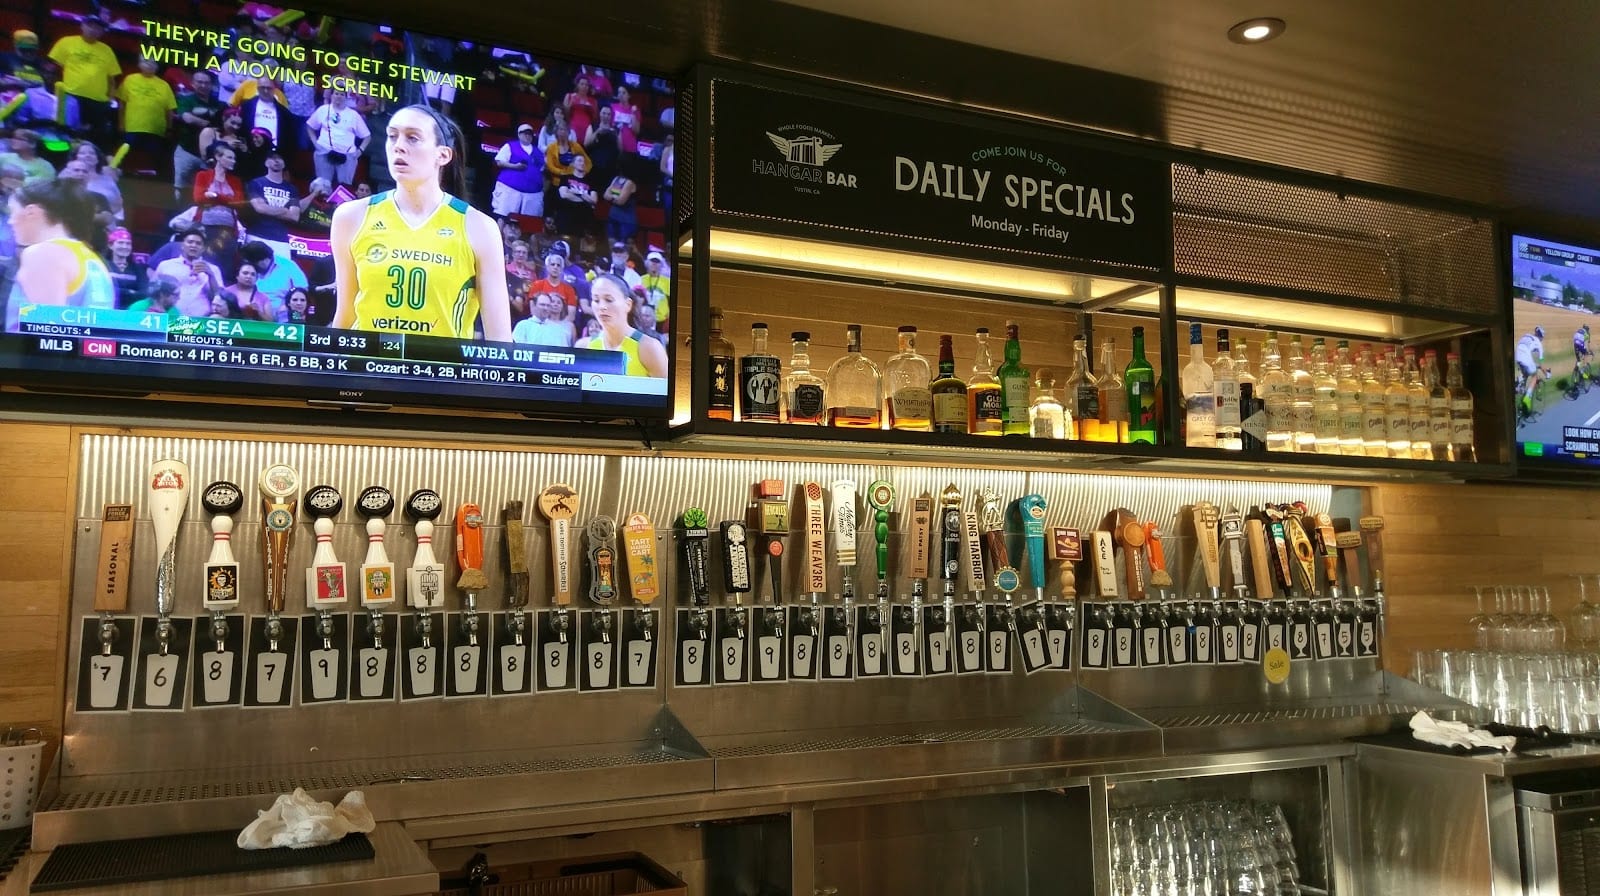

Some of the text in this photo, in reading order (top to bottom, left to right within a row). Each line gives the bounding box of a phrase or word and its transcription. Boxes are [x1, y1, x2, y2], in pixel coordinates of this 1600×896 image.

[142, 20, 476, 91] THEY'RE GOING TO GET STEWART
[141, 44, 398, 102] WITH A MOVING SCREEN,
[972, 146, 1067, 177] COME JOIN US FOR
[752, 160, 858, 188] HANGAR BAR
[896, 156, 1135, 224] DAILY SPECIALS
[972, 214, 1022, 236] Monday
[1032, 224, 1069, 243] Friday
[391, 249, 452, 267] SWEDISH
[386, 265, 426, 310] 30
[62, 309, 97, 324] CHI
[140, 315, 161, 329] 41
[372, 316, 430, 332] verizon
[26, 324, 82, 335] TIMEOUTS:
[206, 319, 244, 335] SEA
[273, 325, 297, 340] 42
[40, 339, 73, 351] MLB
[174, 335, 224, 345] TIMEOUTS:
[310, 334, 366, 348] 3rd 9:33
[88, 343, 112, 354] CIN
[461, 345, 576, 365] WNBA ON ESPN
[120, 345, 348, 370] Romano: 4 IP, 6 H, 6 ER, 5 BB, 3 K
[366, 361, 526, 383] Cozart: 3-4, 2B, HR(10), 2 R
[542, 372, 579, 386] Suárez
[1566, 428, 1579, 437] LOOK
[1580, 429, 1592, 439] HOW
[810, 503, 822, 536] THREE
[630, 538, 650, 546] TART
[966, 514, 983, 580] KING HARBOR
[631, 548, 651, 556] CART
[107, 542, 119, 594] SEASONAL
[1029, 637, 1037, 648] 7
[1092, 634, 1099, 649] 8
[1149, 637, 1155, 649] 7
[1174, 633, 1181, 647] 8
[1200, 632, 1206, 648] 8
[1226, 632, 1233, 648] 8
[1246, 633, 1253, 647] 8
[1272, 634, 1279, 647] 6
[1297, 631, 1304, 643] 8
[1321, 633, 1327, 645] 7
[1341, 631, 1348, 643] 5
[1363, 628, 1370, 642] 5
[797, 643, 806, 660] 8
[834, 643, 842, 660] 8
[867, 641, 876, 658] 8
[902, 640, 910, 655] 8
[934, 640, 941, 655] 9
[966, 638, 975, 654] 8
[995, 638, 1002, 654] 8
[1053, 638, 1060, 654] 9
[1120, 636, 1127, 651] 8
[460, 652, 471, 672] 8
[551, 650, 560, 667] 8
[594, 651, 603, 669] 8
[634, 653, 642, 667] 7
[688, 646, 697, 664] 8
[727, 647, 735, 665] 8
[765, 647, 773, 664] 9
[209, 660, 222, 680] 8
[319, 659, 329, 677] 9
[366, 656, 378, 677] 8
[417, 655, 427, 673] 8
[508, 656, 517, 672] 8
[1269, 660, 1285, 671] Sale
[154, 667, 166, 687] 6
[264, 664, 276, 681] 7
